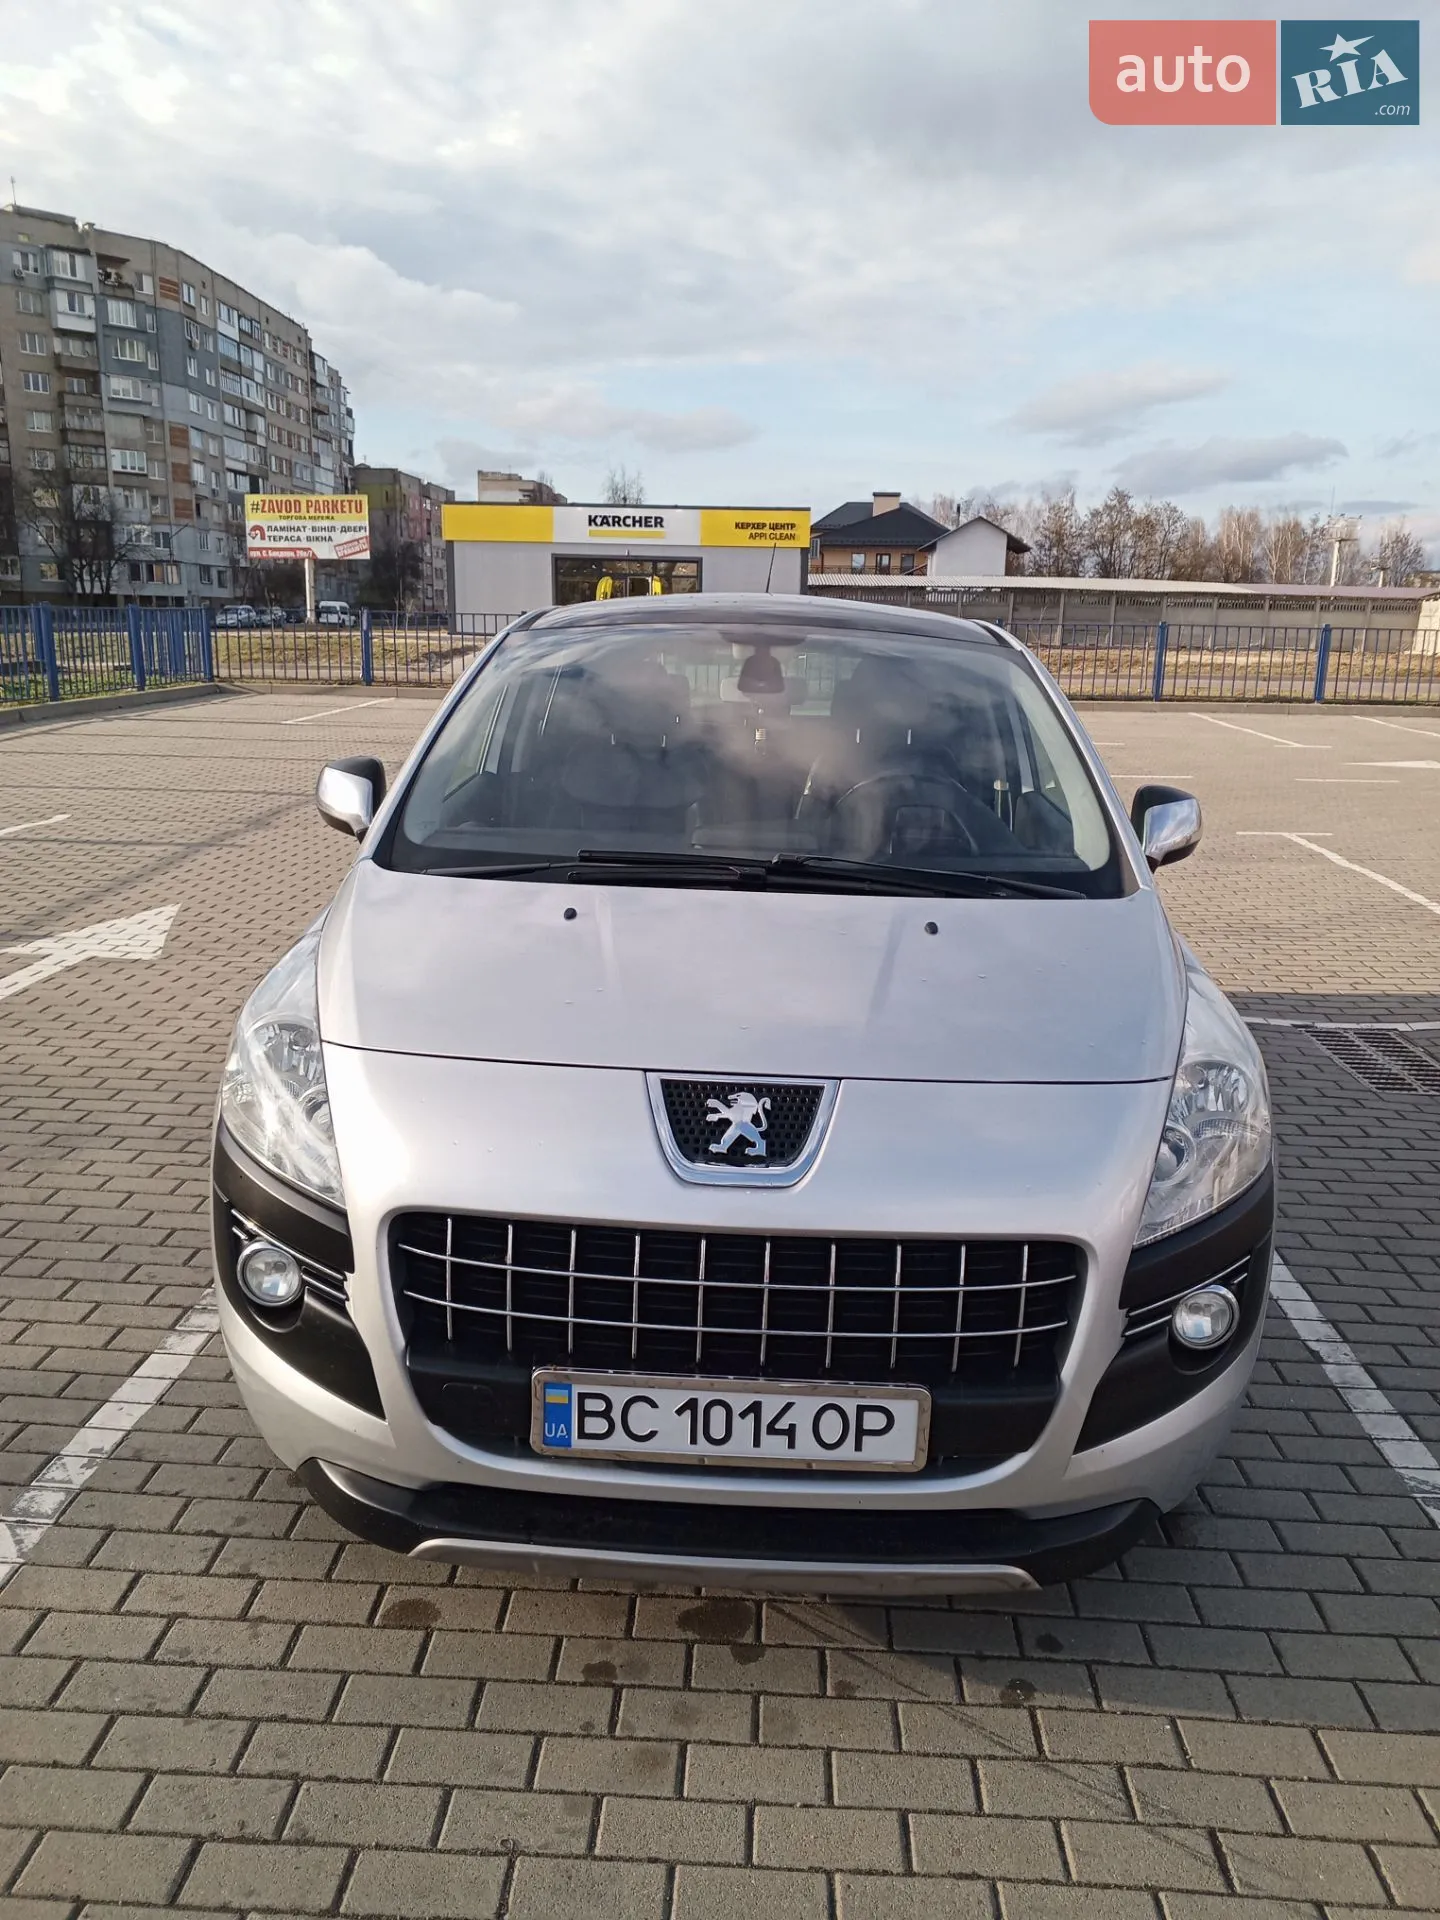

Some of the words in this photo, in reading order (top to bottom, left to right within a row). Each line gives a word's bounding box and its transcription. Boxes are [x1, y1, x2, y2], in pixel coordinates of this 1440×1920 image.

[250, 499, 302, 514] #ZAVOD
[306, 499, 363, 514] PARKETU
[588, 514, 664, 528] KÄRCHER
[735, 522, 766, 530] КЕРХЕР
[769, 522, 796, 531] ЦЕНТР
[267, 535, 302, 543] ТЕРАСА
[306, 535, 333, 543] ВІКНА
[748, 532, 767, 540] APPI
[769, 532, 796, 541] CLEAN
[576, 1391, 659, 1443] BC
[674, 1397, 797, 1450] 1014
[812, 1402, 896, 1452] OP
[545, 1422, 567, 1439] UA
